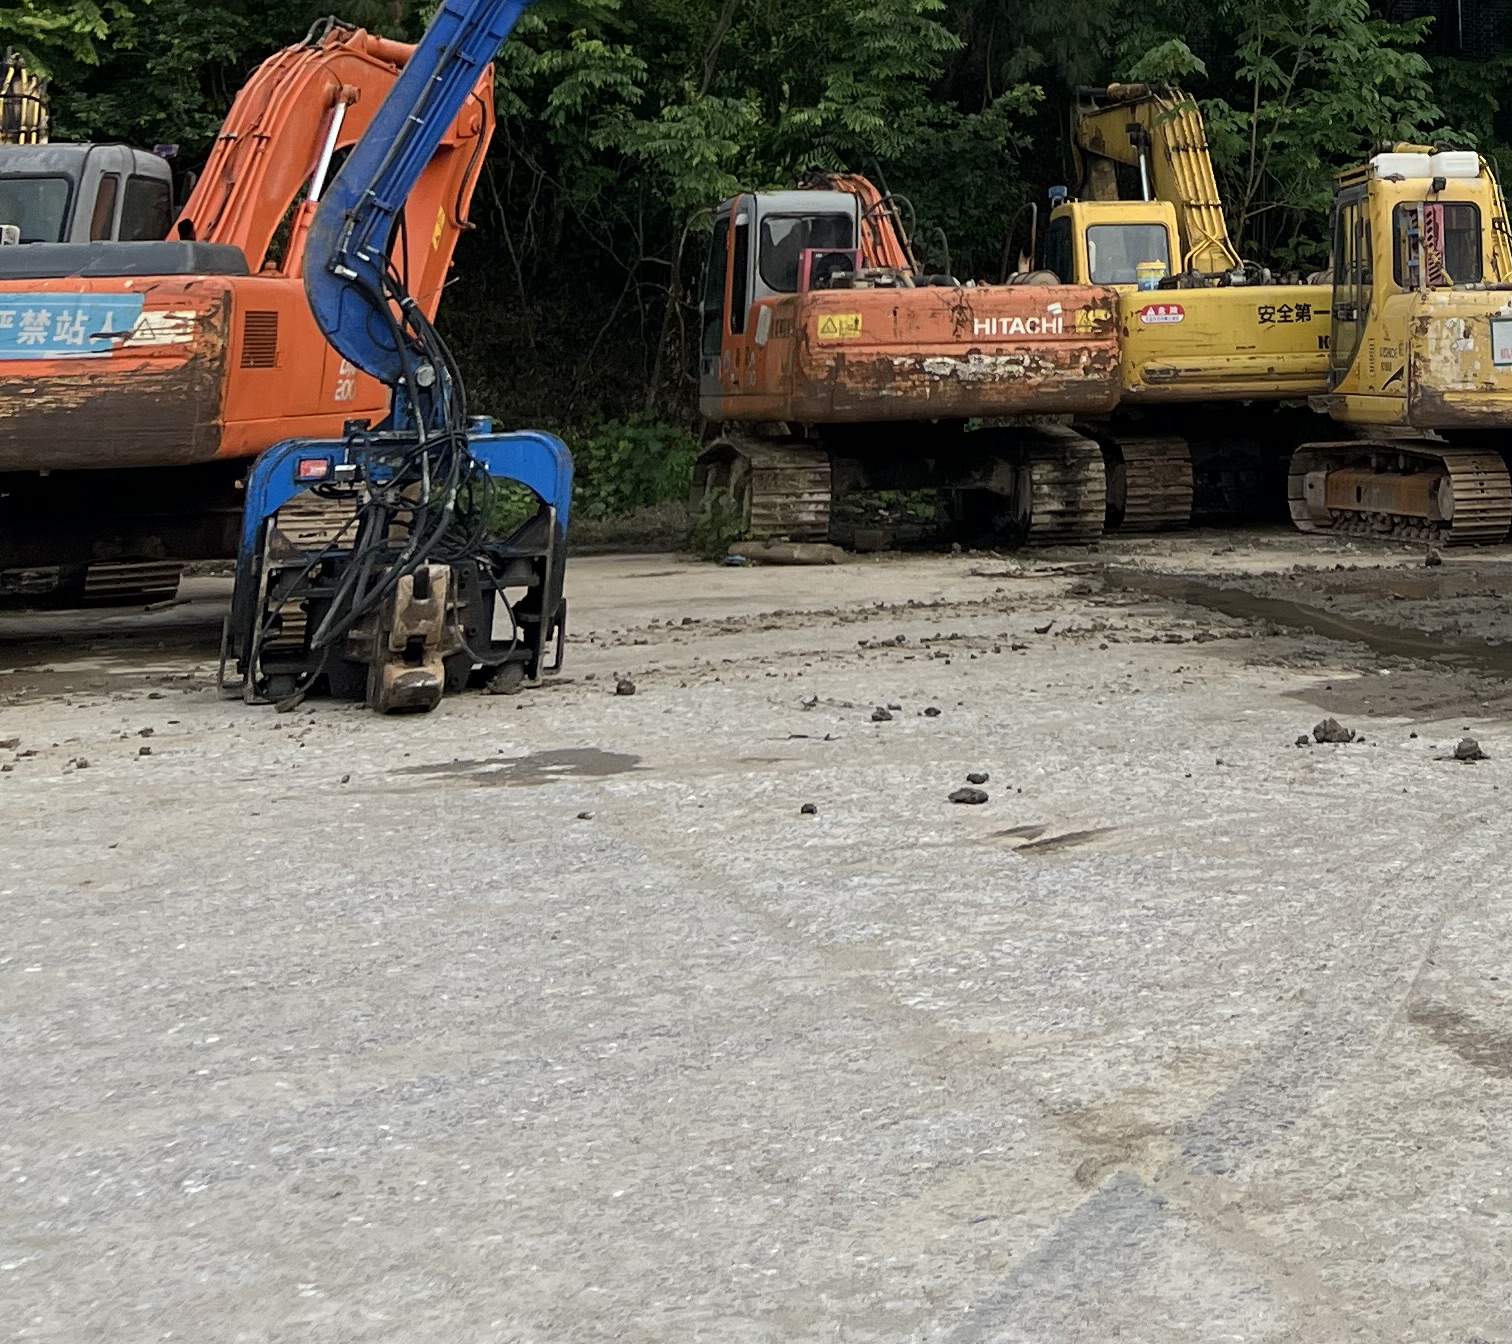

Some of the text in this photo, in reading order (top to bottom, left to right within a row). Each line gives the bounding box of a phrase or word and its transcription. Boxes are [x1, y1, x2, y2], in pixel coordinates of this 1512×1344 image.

[1258, 303, 1330, 324] 安全第一
[974, 317, 1062, 335] HITACHI
